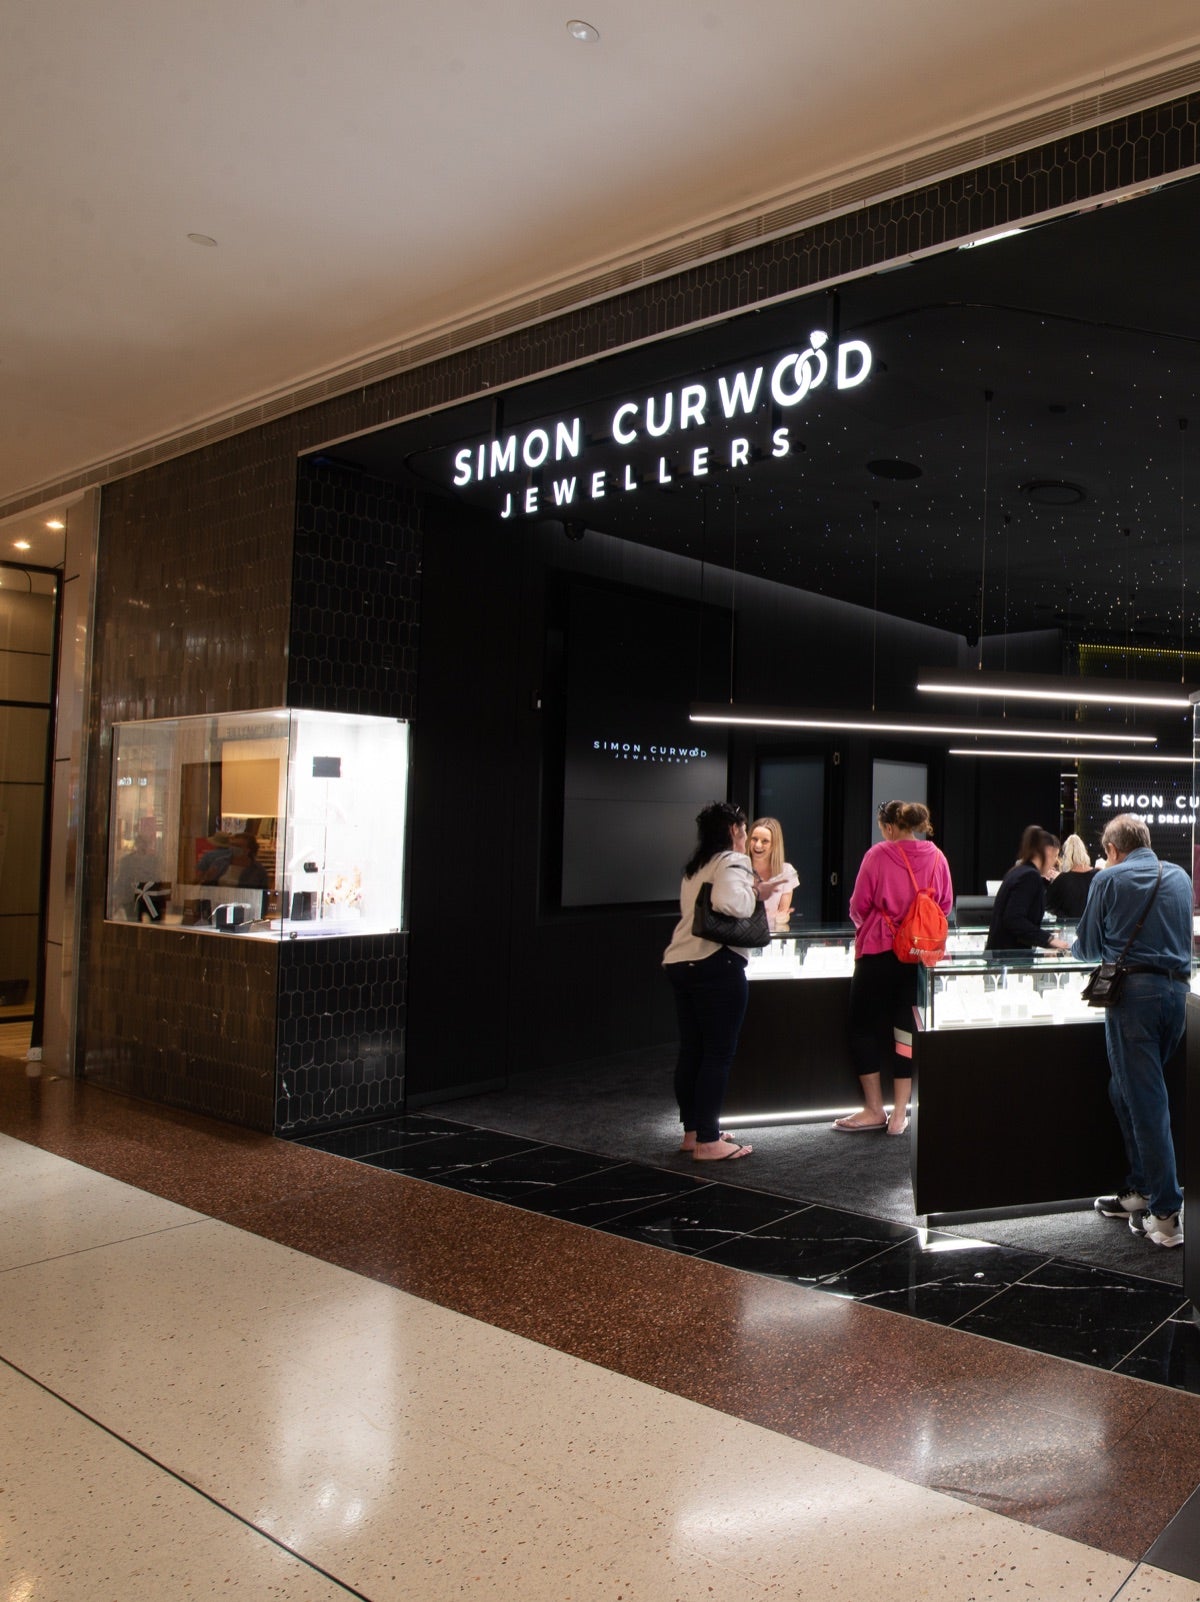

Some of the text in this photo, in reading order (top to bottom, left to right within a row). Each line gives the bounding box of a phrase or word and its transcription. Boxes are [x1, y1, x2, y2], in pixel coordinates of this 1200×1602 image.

[453, 330, 873, 486] SIMON CURWOOD
[500, 427, 790, 519] JEWELLERS
[593, 740, 707, 758] SIMON CURWOOD
[1102, 794, 1163, 808] SIMON
